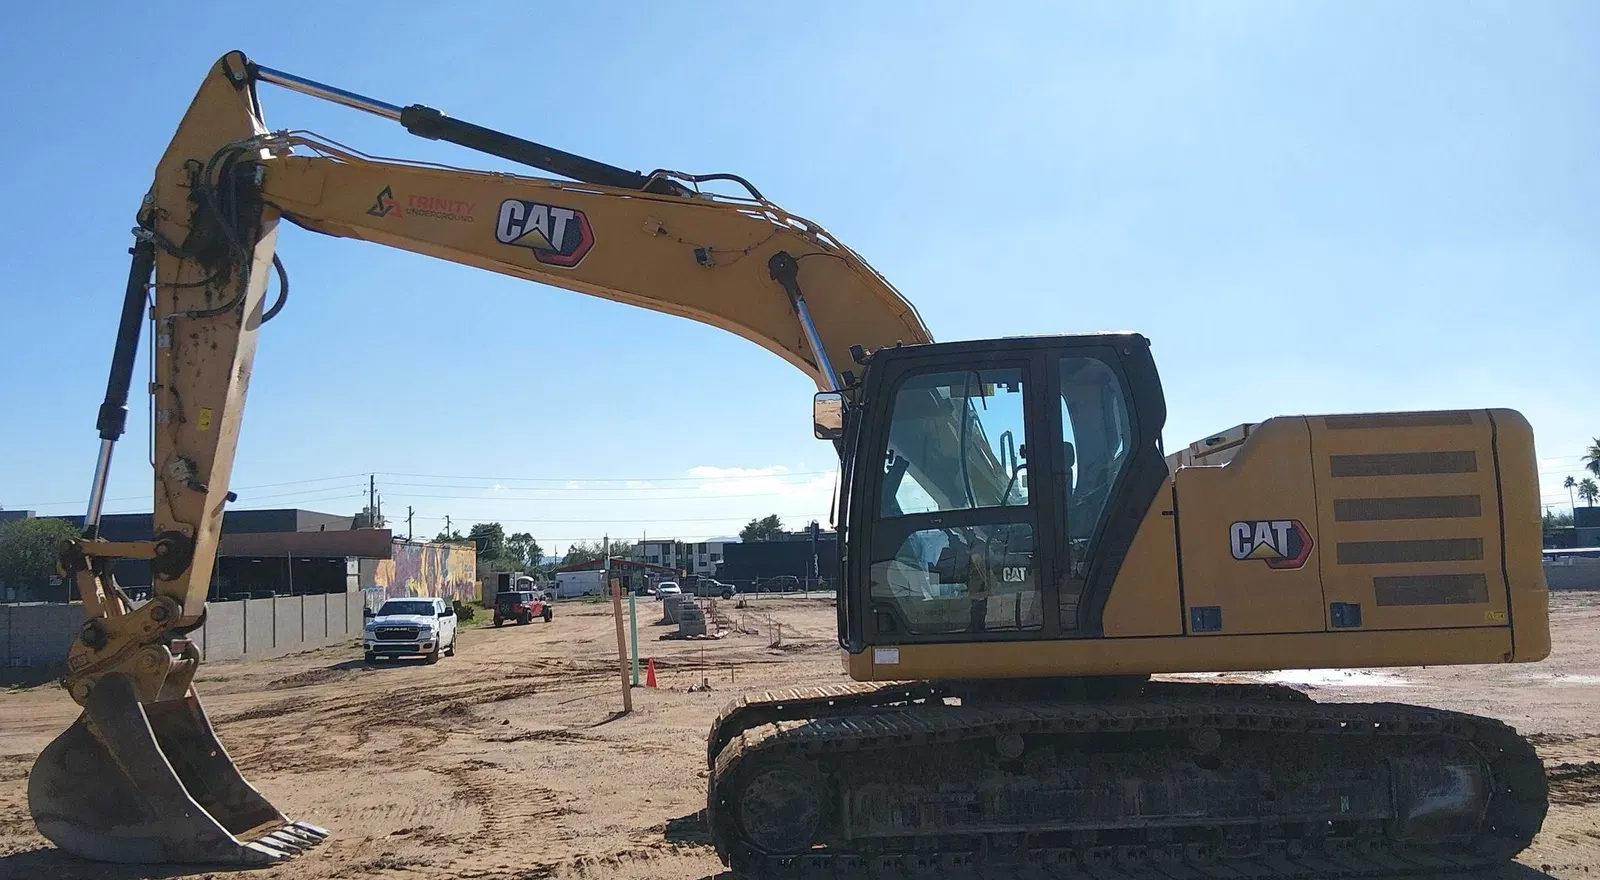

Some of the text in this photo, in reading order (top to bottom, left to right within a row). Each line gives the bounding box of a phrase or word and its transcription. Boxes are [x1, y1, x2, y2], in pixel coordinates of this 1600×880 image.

[408, 194, 476, 214] TRINITY
[405, 207, 475, 222] UNDERGROUND
[497, 199, 575, 252] CAT
[1230, 520, 1292, 559] CAT
[1002, 566, 1027, 582] CAT
